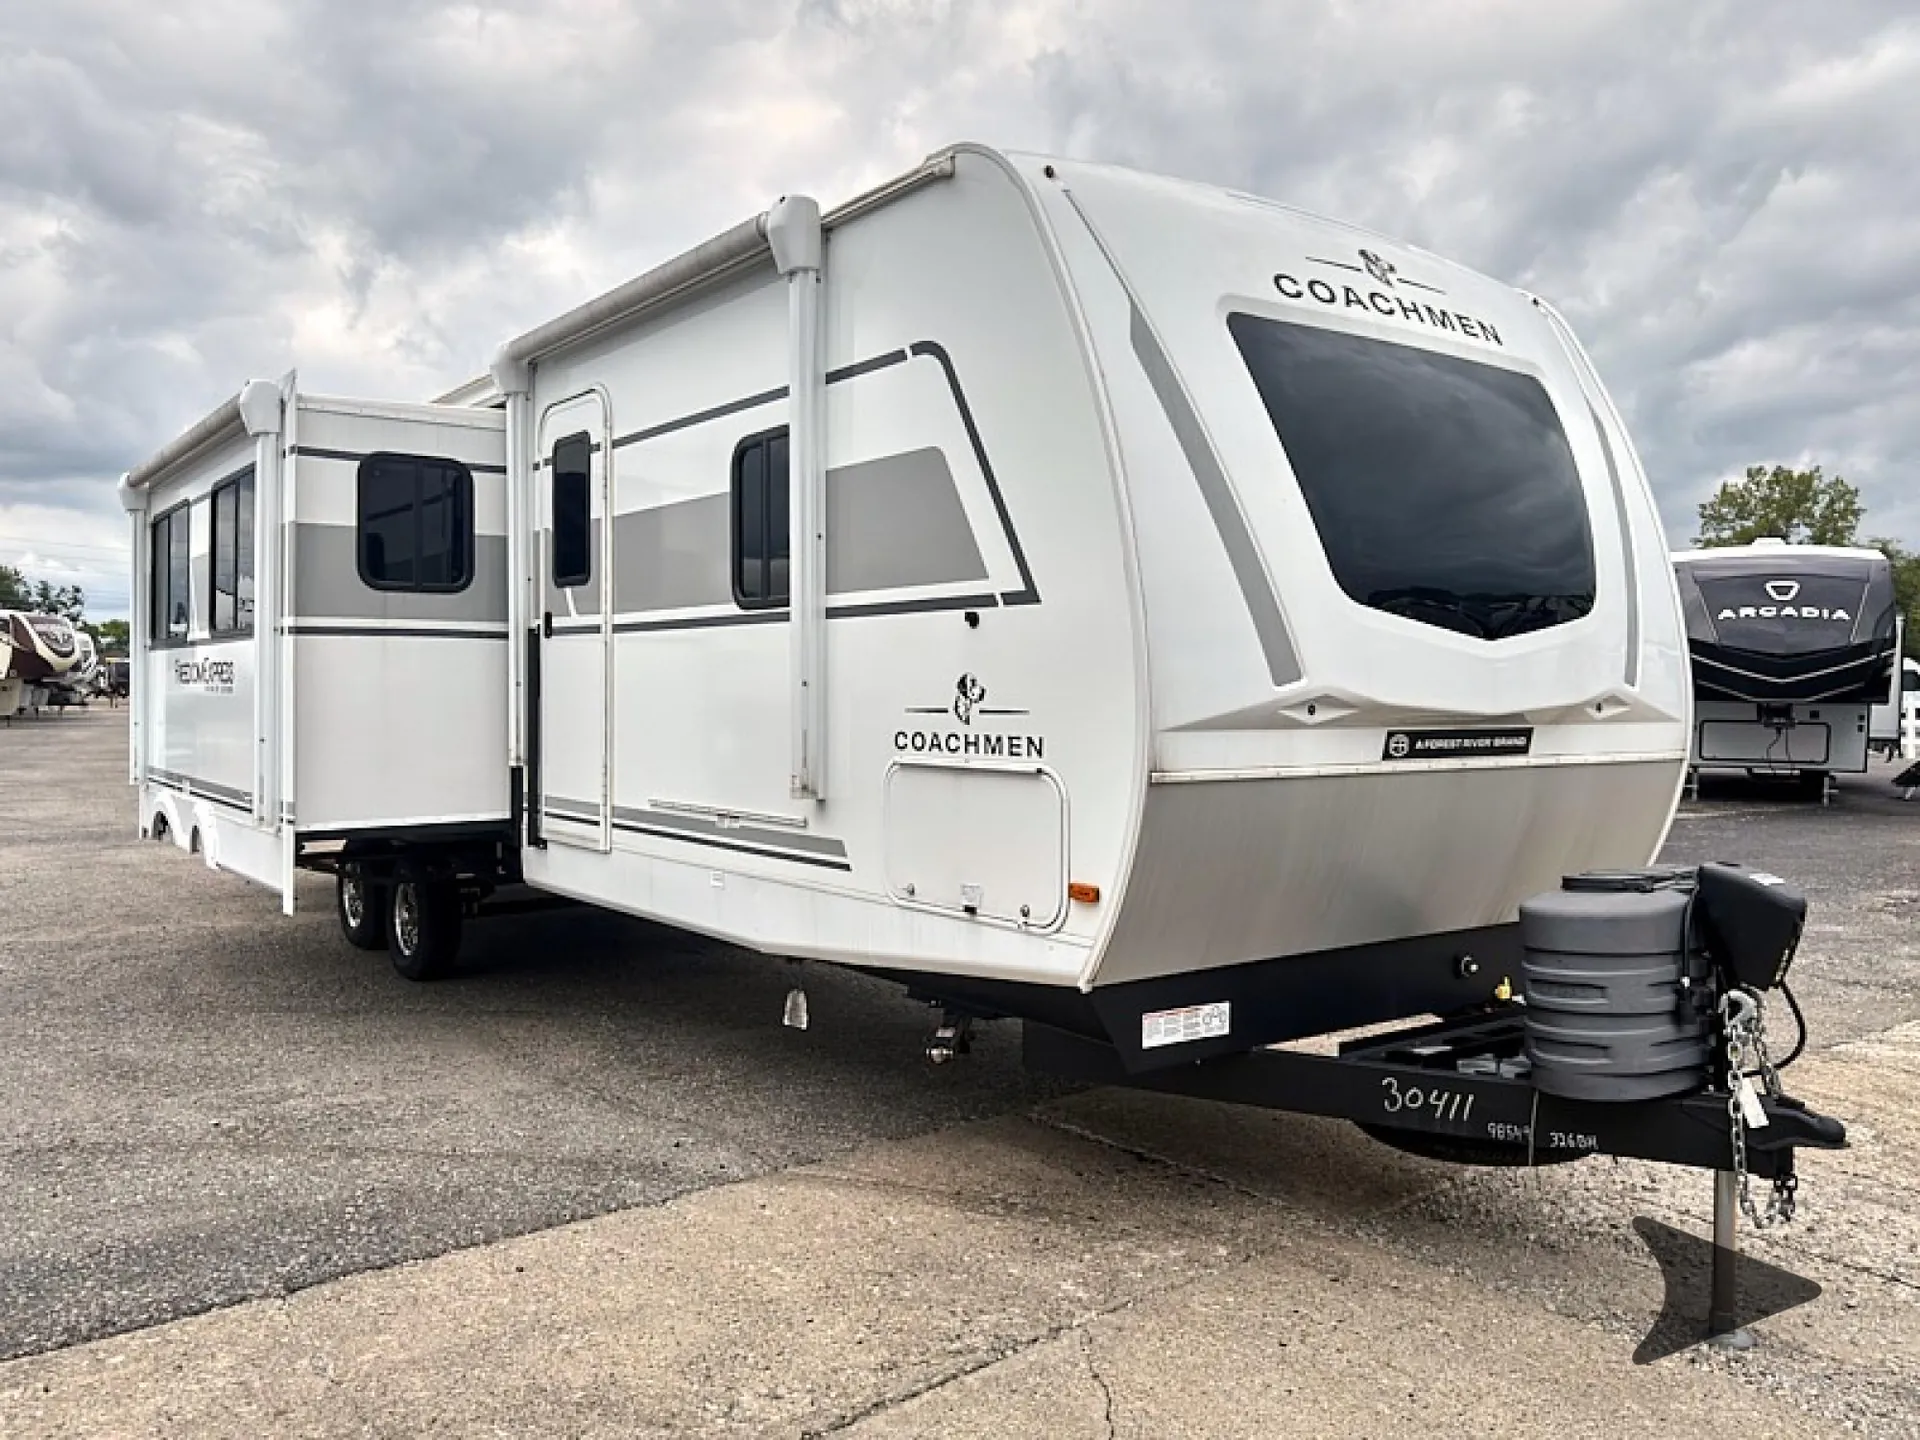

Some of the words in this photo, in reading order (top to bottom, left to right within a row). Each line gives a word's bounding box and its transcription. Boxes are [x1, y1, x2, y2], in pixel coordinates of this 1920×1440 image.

[1273, 272, 1503, 347] COACHMEN
[1717, 606, 1851, 620] ARCADIA
[894, 730, 1045, 758] COACHMEN
[1426, 738, 1462, 749] FOREST
[1464, 737, 1491, 747] RIVER
[1381, 1076, 1475, 1122] 30411
